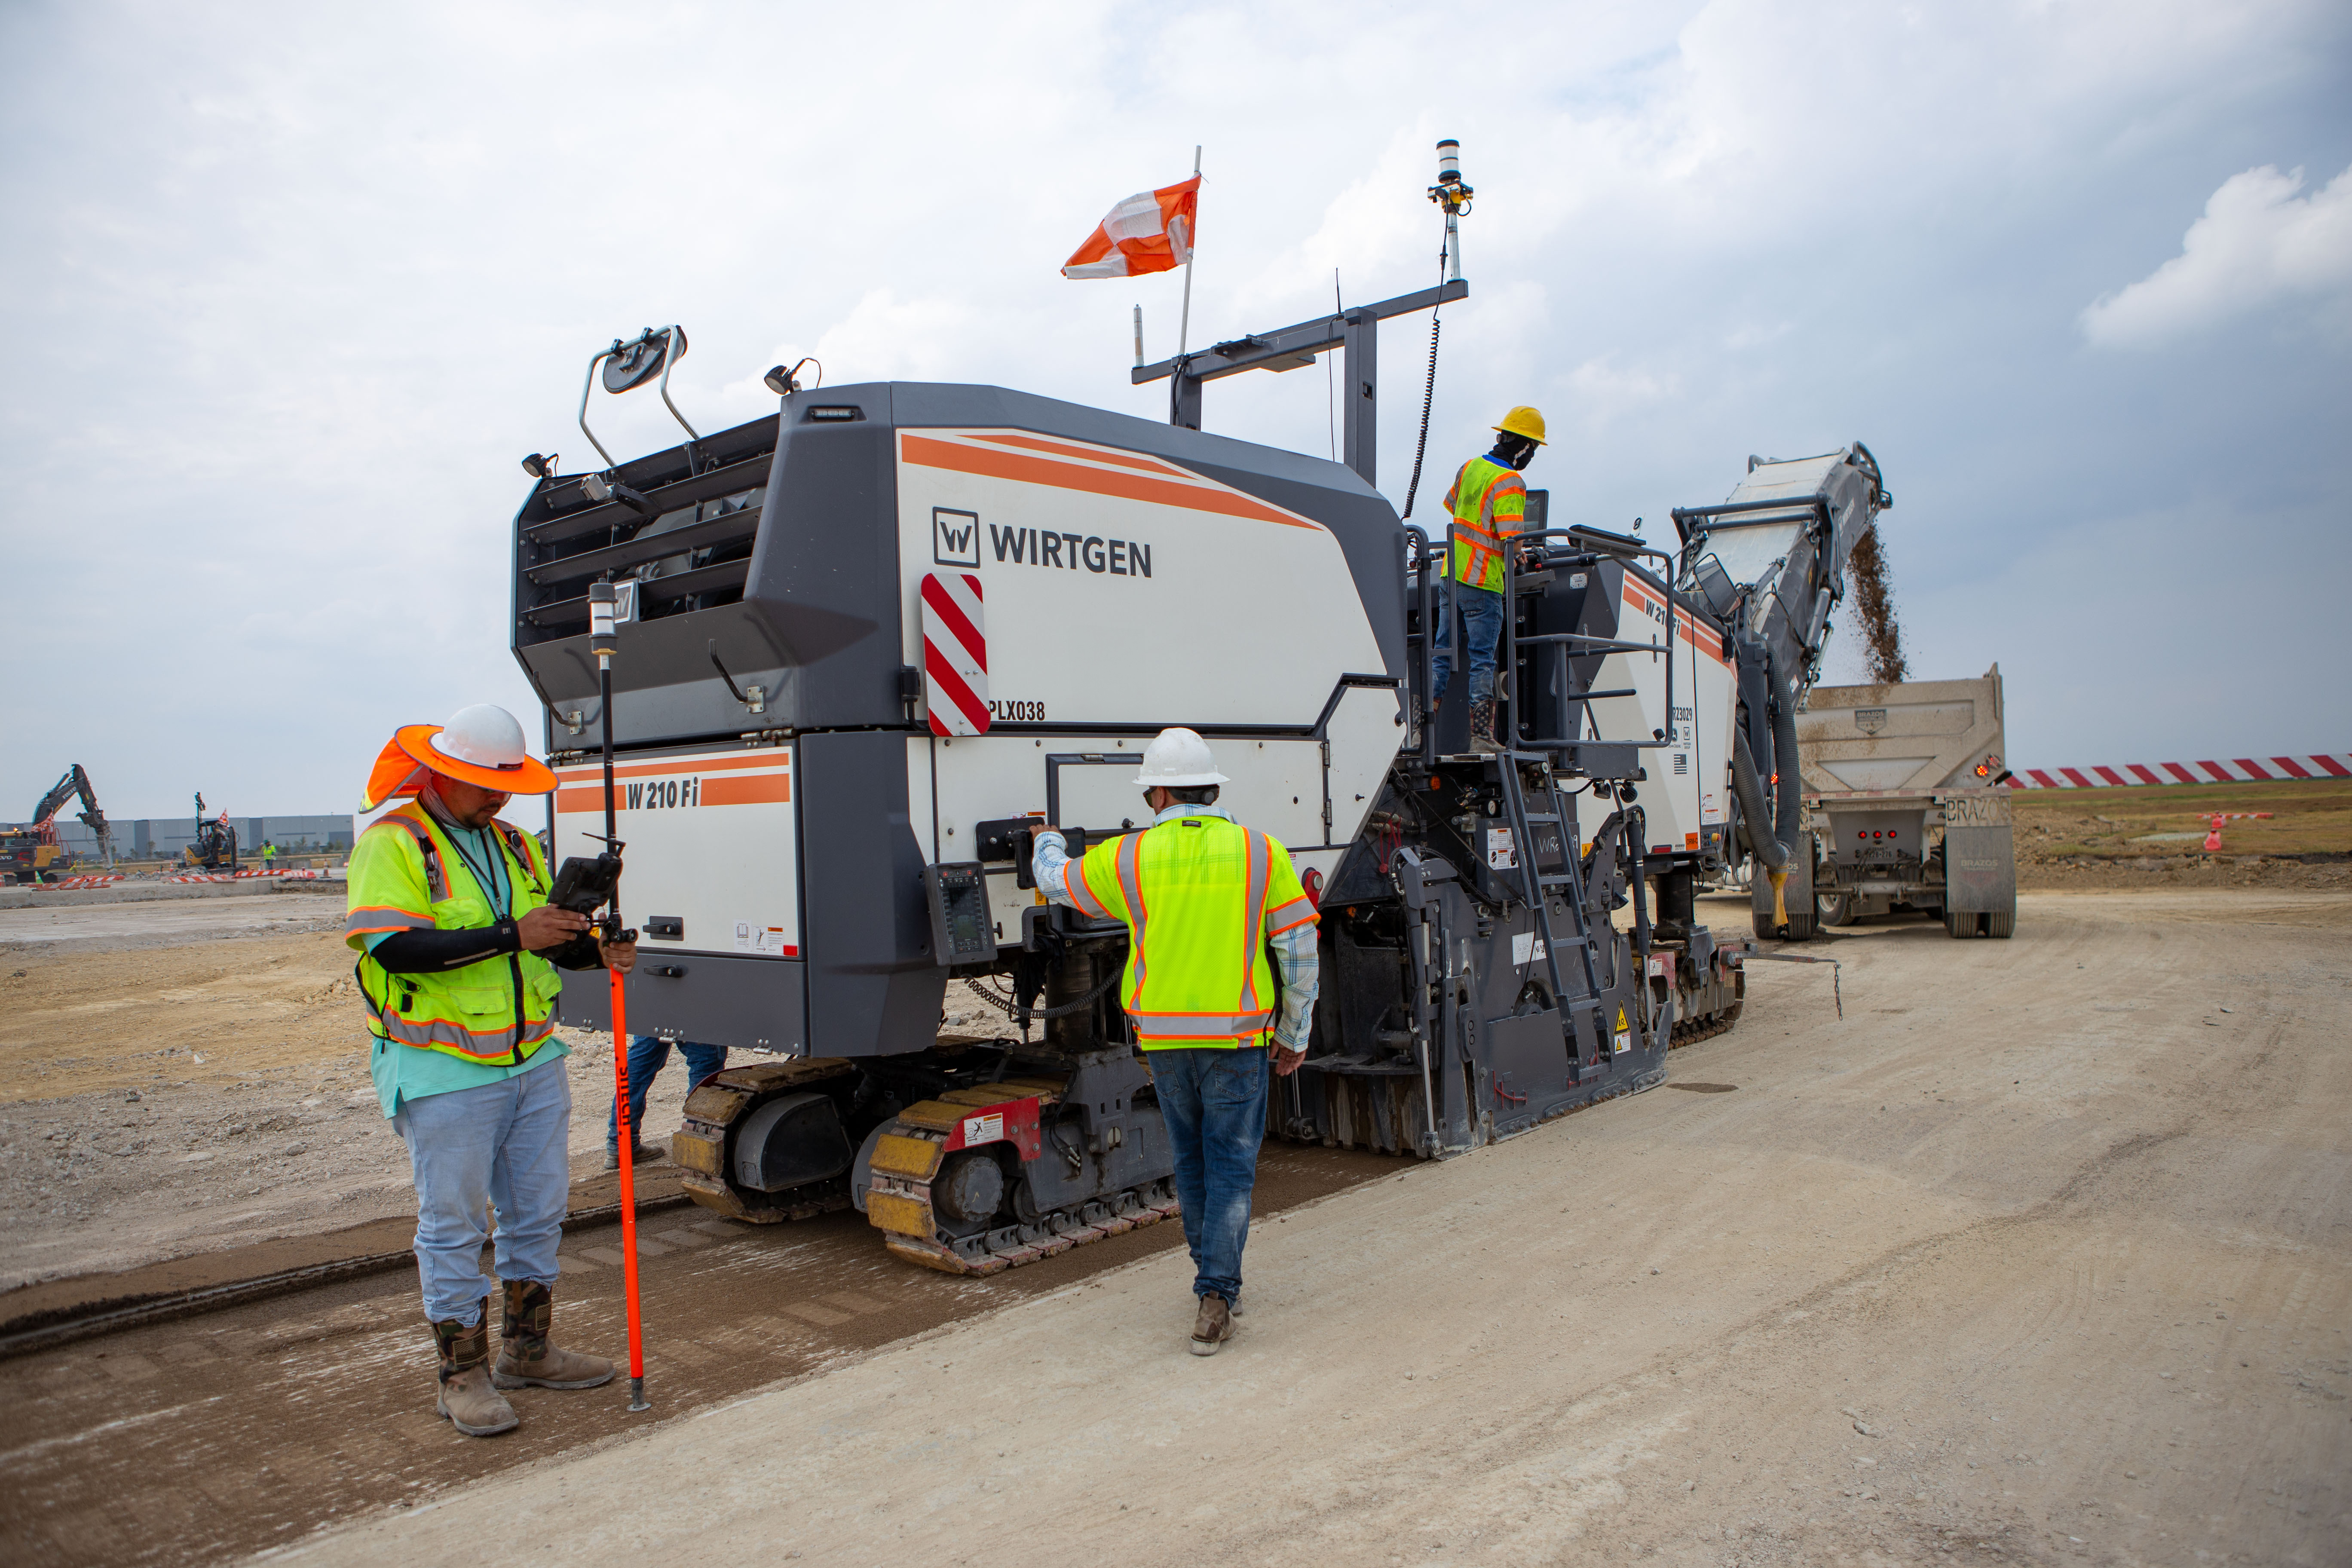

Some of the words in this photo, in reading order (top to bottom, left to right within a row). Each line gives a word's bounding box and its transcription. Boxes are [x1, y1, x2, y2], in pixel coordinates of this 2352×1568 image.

[989, 524, 1152, 578] WIRTGEN
[1646, 599, 1655, 617] W
[1655, 606, 1667, 627] 21
[989, 700, 1045, 721] PLX038
[1672, 707, 1692, 721] R23029
[62, 786, 77, 799] VOLVO
[629, 783, 644, 809] W
[647, 781, 677, 809] 210
[686, 776, 698, 807] Fi
[1947, 798, 2010, 822] BRAZOS
